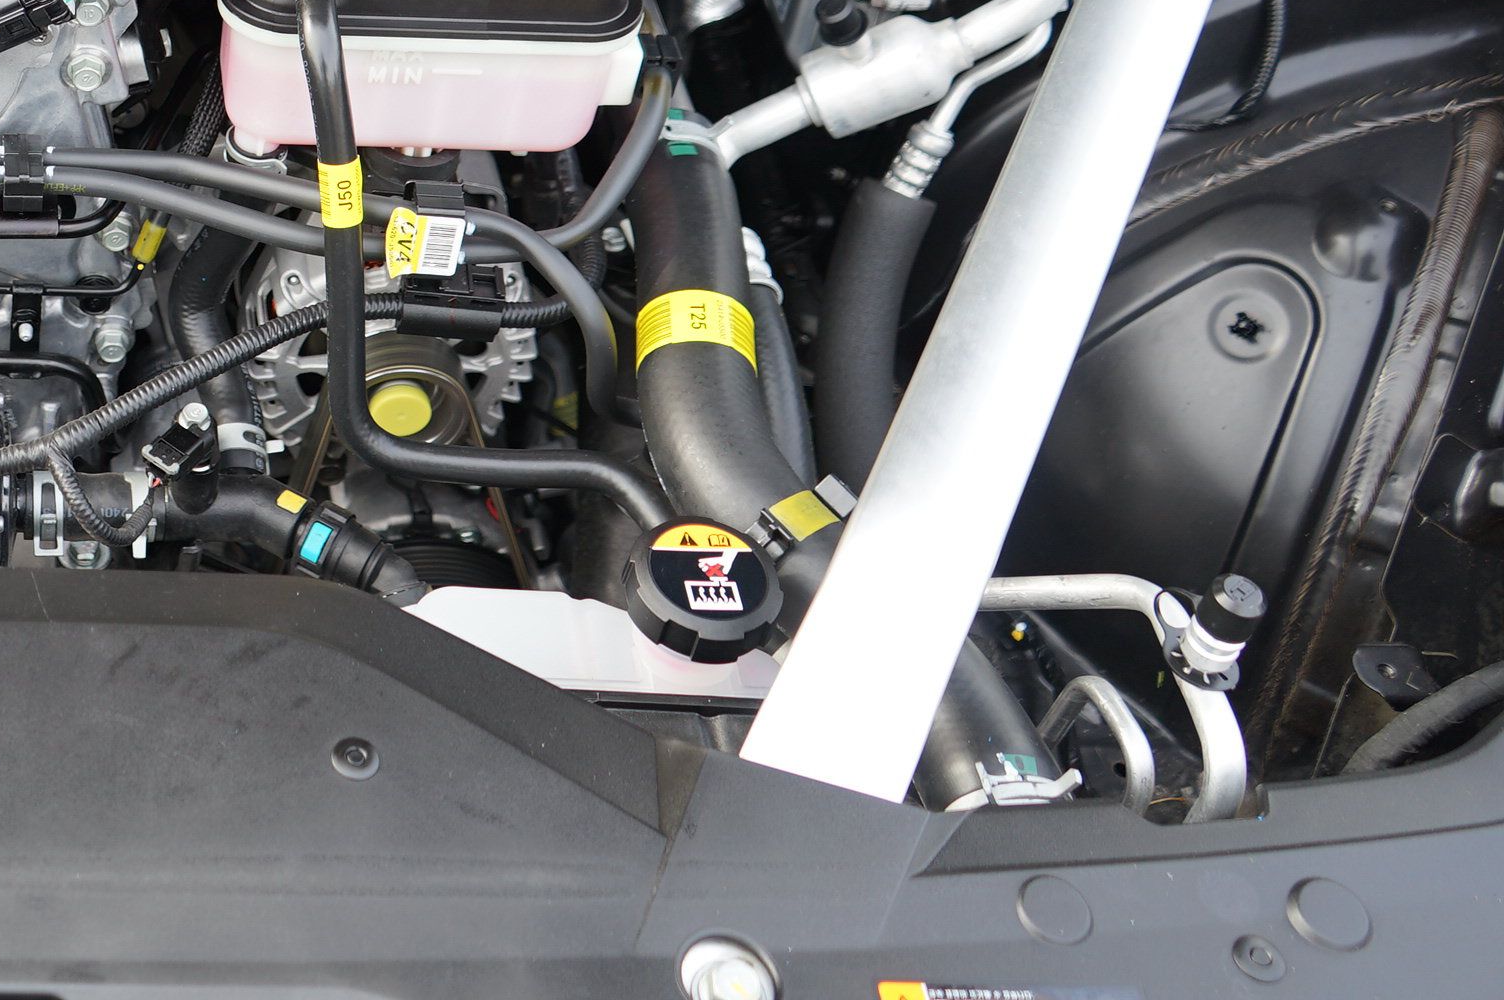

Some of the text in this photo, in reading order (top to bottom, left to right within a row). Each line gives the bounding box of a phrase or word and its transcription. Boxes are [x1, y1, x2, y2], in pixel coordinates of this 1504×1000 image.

[367, 66, 424, 84] MIN
[337, 180, 353, 211] J50
[688, 303, 707, 330] T25
